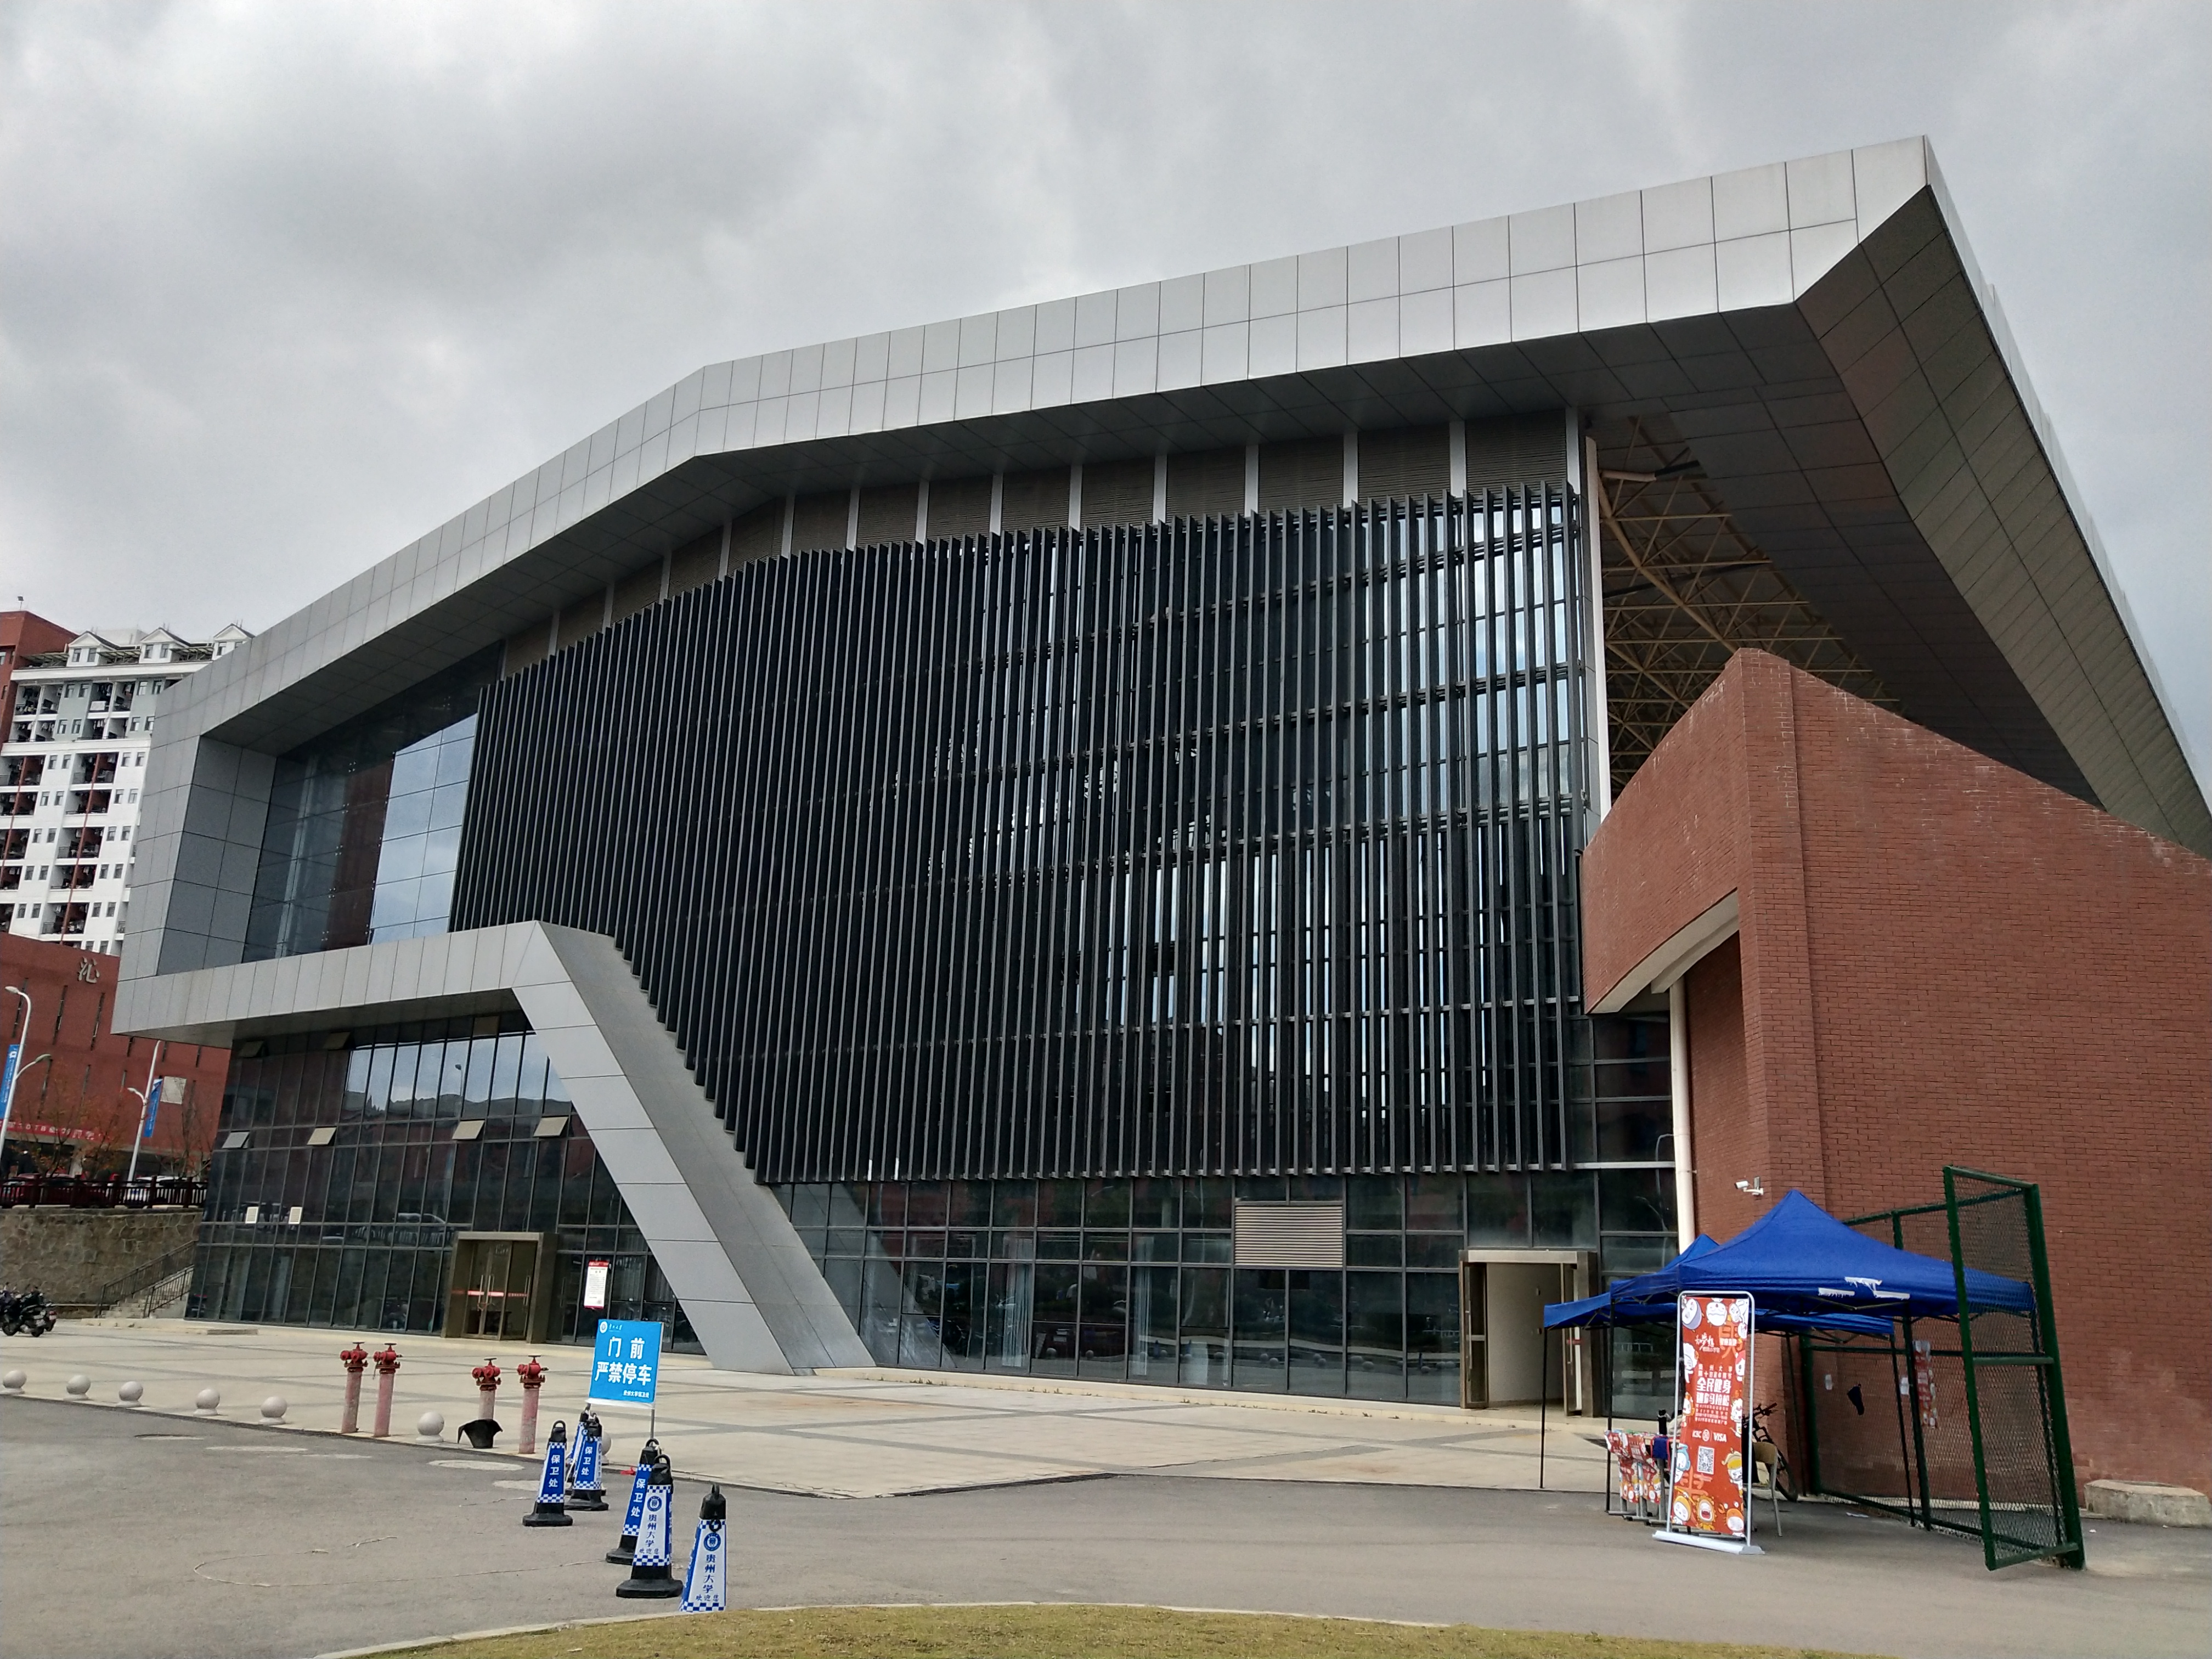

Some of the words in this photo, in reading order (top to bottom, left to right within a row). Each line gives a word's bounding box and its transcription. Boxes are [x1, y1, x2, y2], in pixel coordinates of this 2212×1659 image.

[78, 956, 100, 983] 沁
[608, 1336, 645, 1359] 门前
[595, 1361, 652, 1386] 严禁停车
[1696, 1377, 1731, 1394] 全民健身
[1713, 1432, 1727, 1442] VISA
[549, 1454, 560, 1488] 保卫处
[581, 1446, 593, 1476] 保卫处
[631, 1478, 646, 1517] 保卫处
[645, 1514, 657, 1548] 贵州大学
[703, 1554, 716, 1594] 贵州大学
[696, 1594, 719, 1602] 欢迎您
